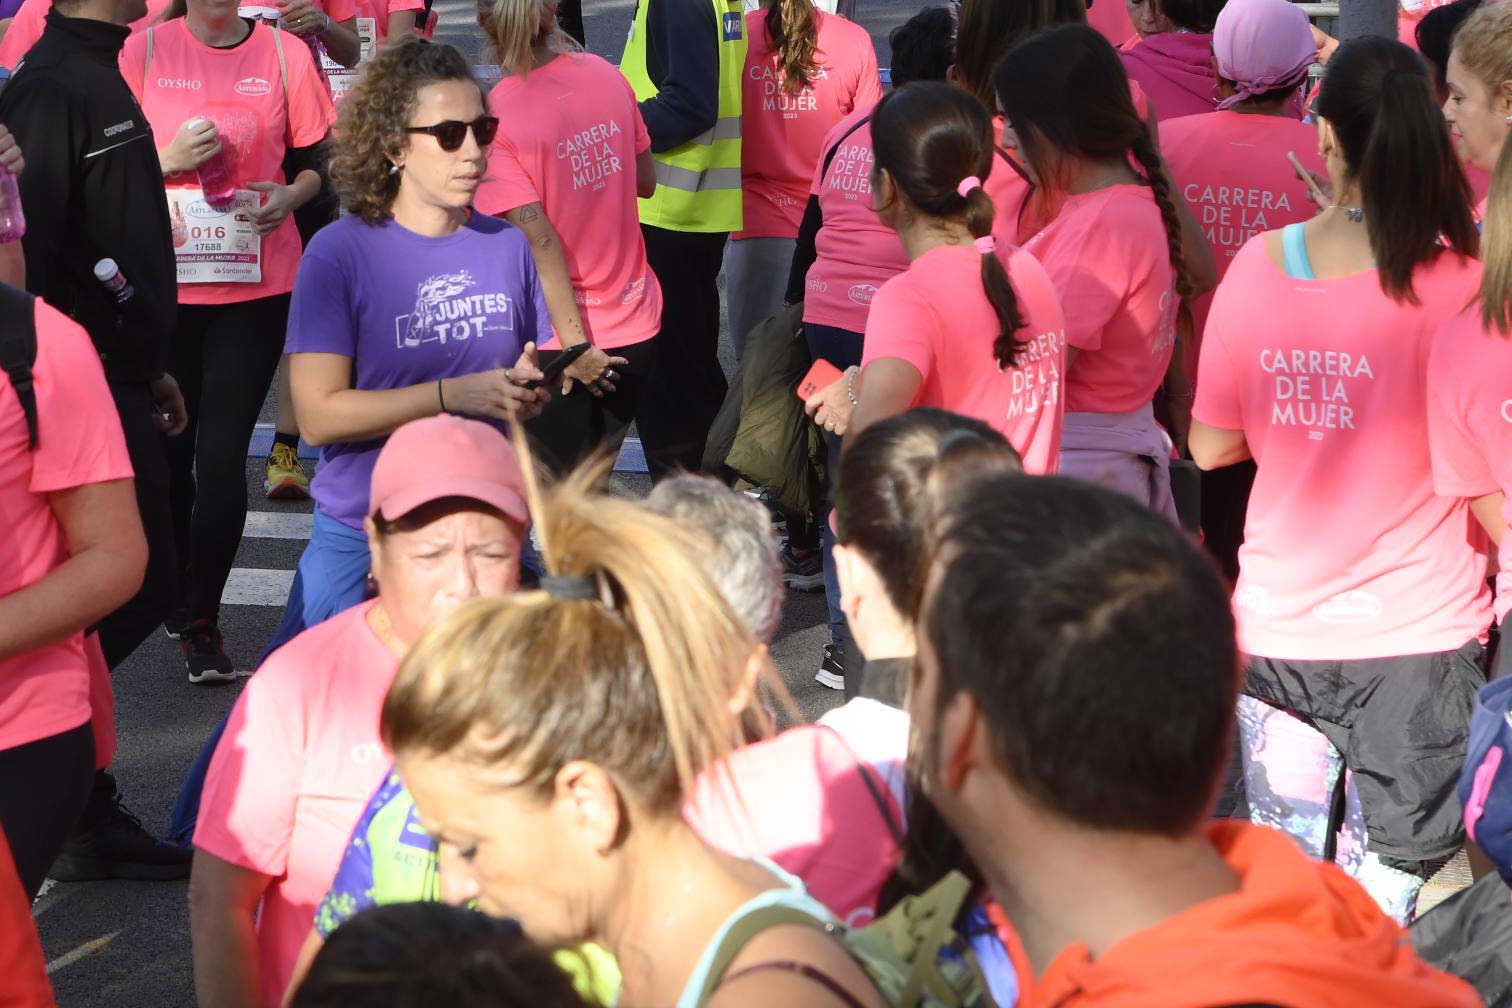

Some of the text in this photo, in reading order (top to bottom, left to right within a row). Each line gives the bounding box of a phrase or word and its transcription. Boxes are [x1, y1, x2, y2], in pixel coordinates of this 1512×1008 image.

[157, 77, 202, 91] OYSHO
[763, 96, 818, 112] MUJER
[556, 120, 623, 159] CARRERA
[570, 141, 615, 172] DE LA
[835, 159, 854, 174] DE
[573, 157, 623, 190] MUJER
[1184, 184, 1292, 212] CARRERA
[1203, 205, 1268, 230] DE LA
[190, 226, 226, 239] 016
[194, 243, 222, 251] 17688
[178, 267, 197, 276] SHO
[436, 293, 508, 320] JUNTES
[433, 317, 488, 345] TOT
[1260, 349, 1375, 379] CARRERA
[1013, 367, 1034, 395] DE
[1276, 376, 1349, 403] DE LA
[1272, 402, 1356, 430] MUJER
